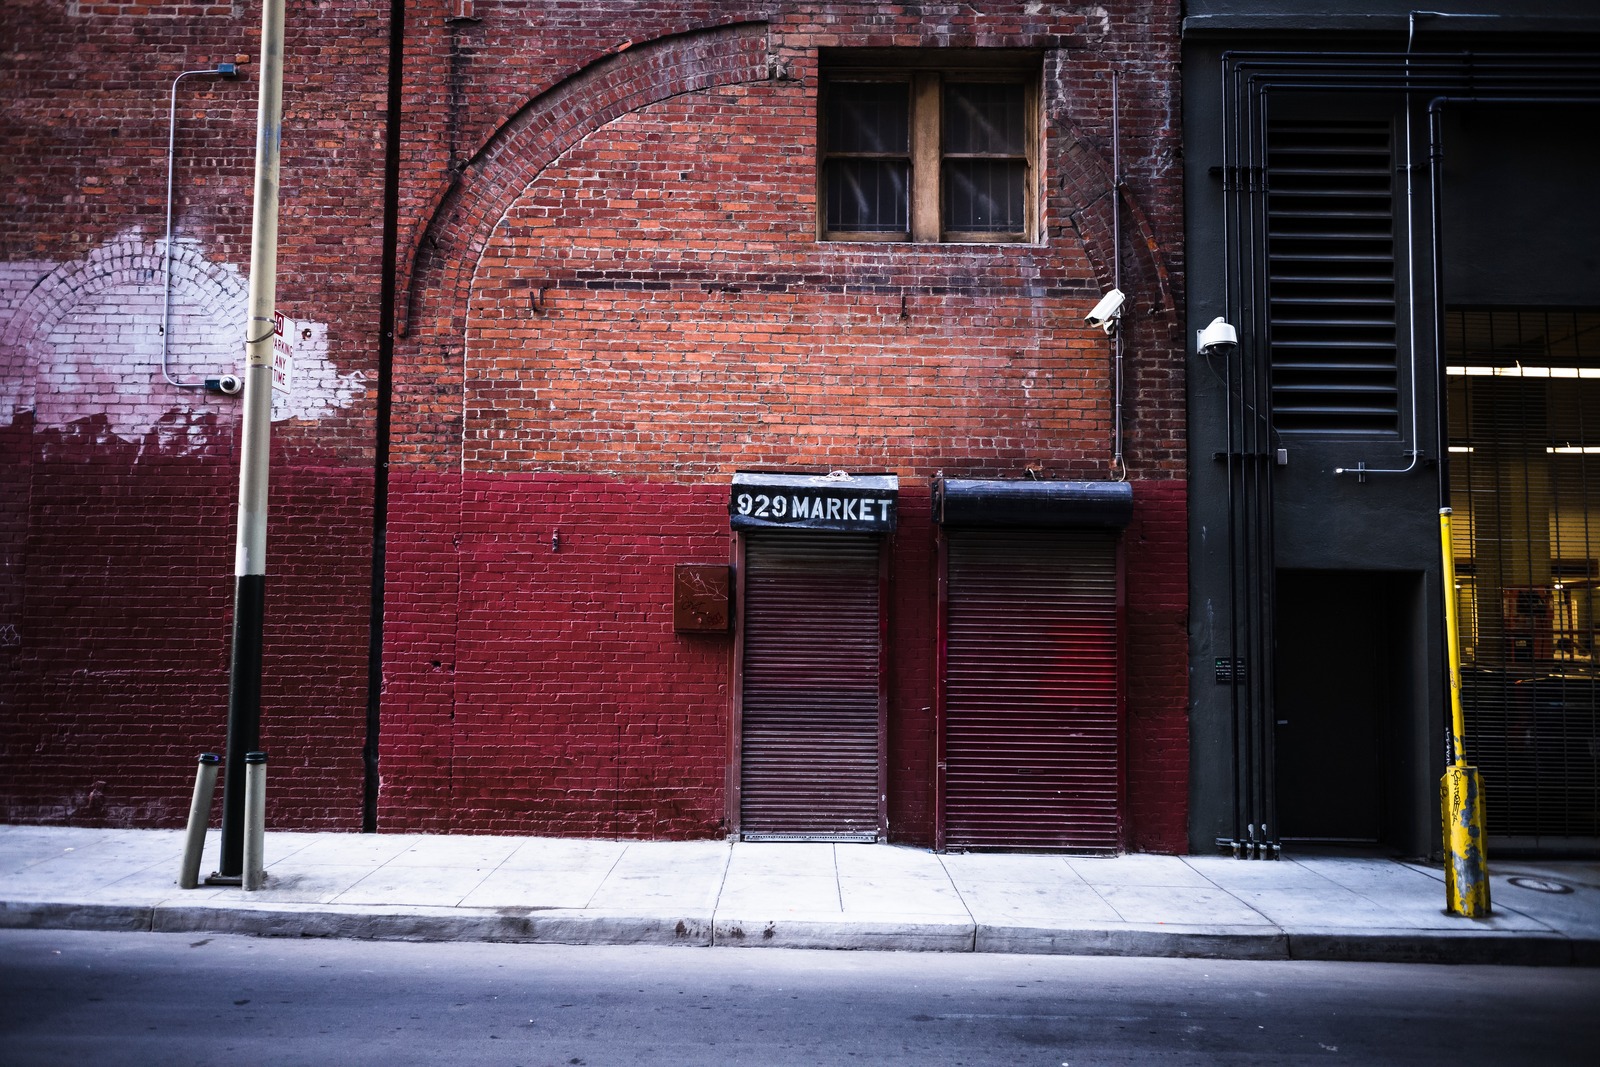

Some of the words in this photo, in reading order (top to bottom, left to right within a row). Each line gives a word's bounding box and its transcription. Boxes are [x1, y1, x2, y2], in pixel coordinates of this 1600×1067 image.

[273, 338, 293, 357] ARKING
[275, 355, 286, 370] ANY
[274, 369, 286, 386] TIME
[737, 493, 787, 517] 929
[792, 495, 893, 521] MARKET
